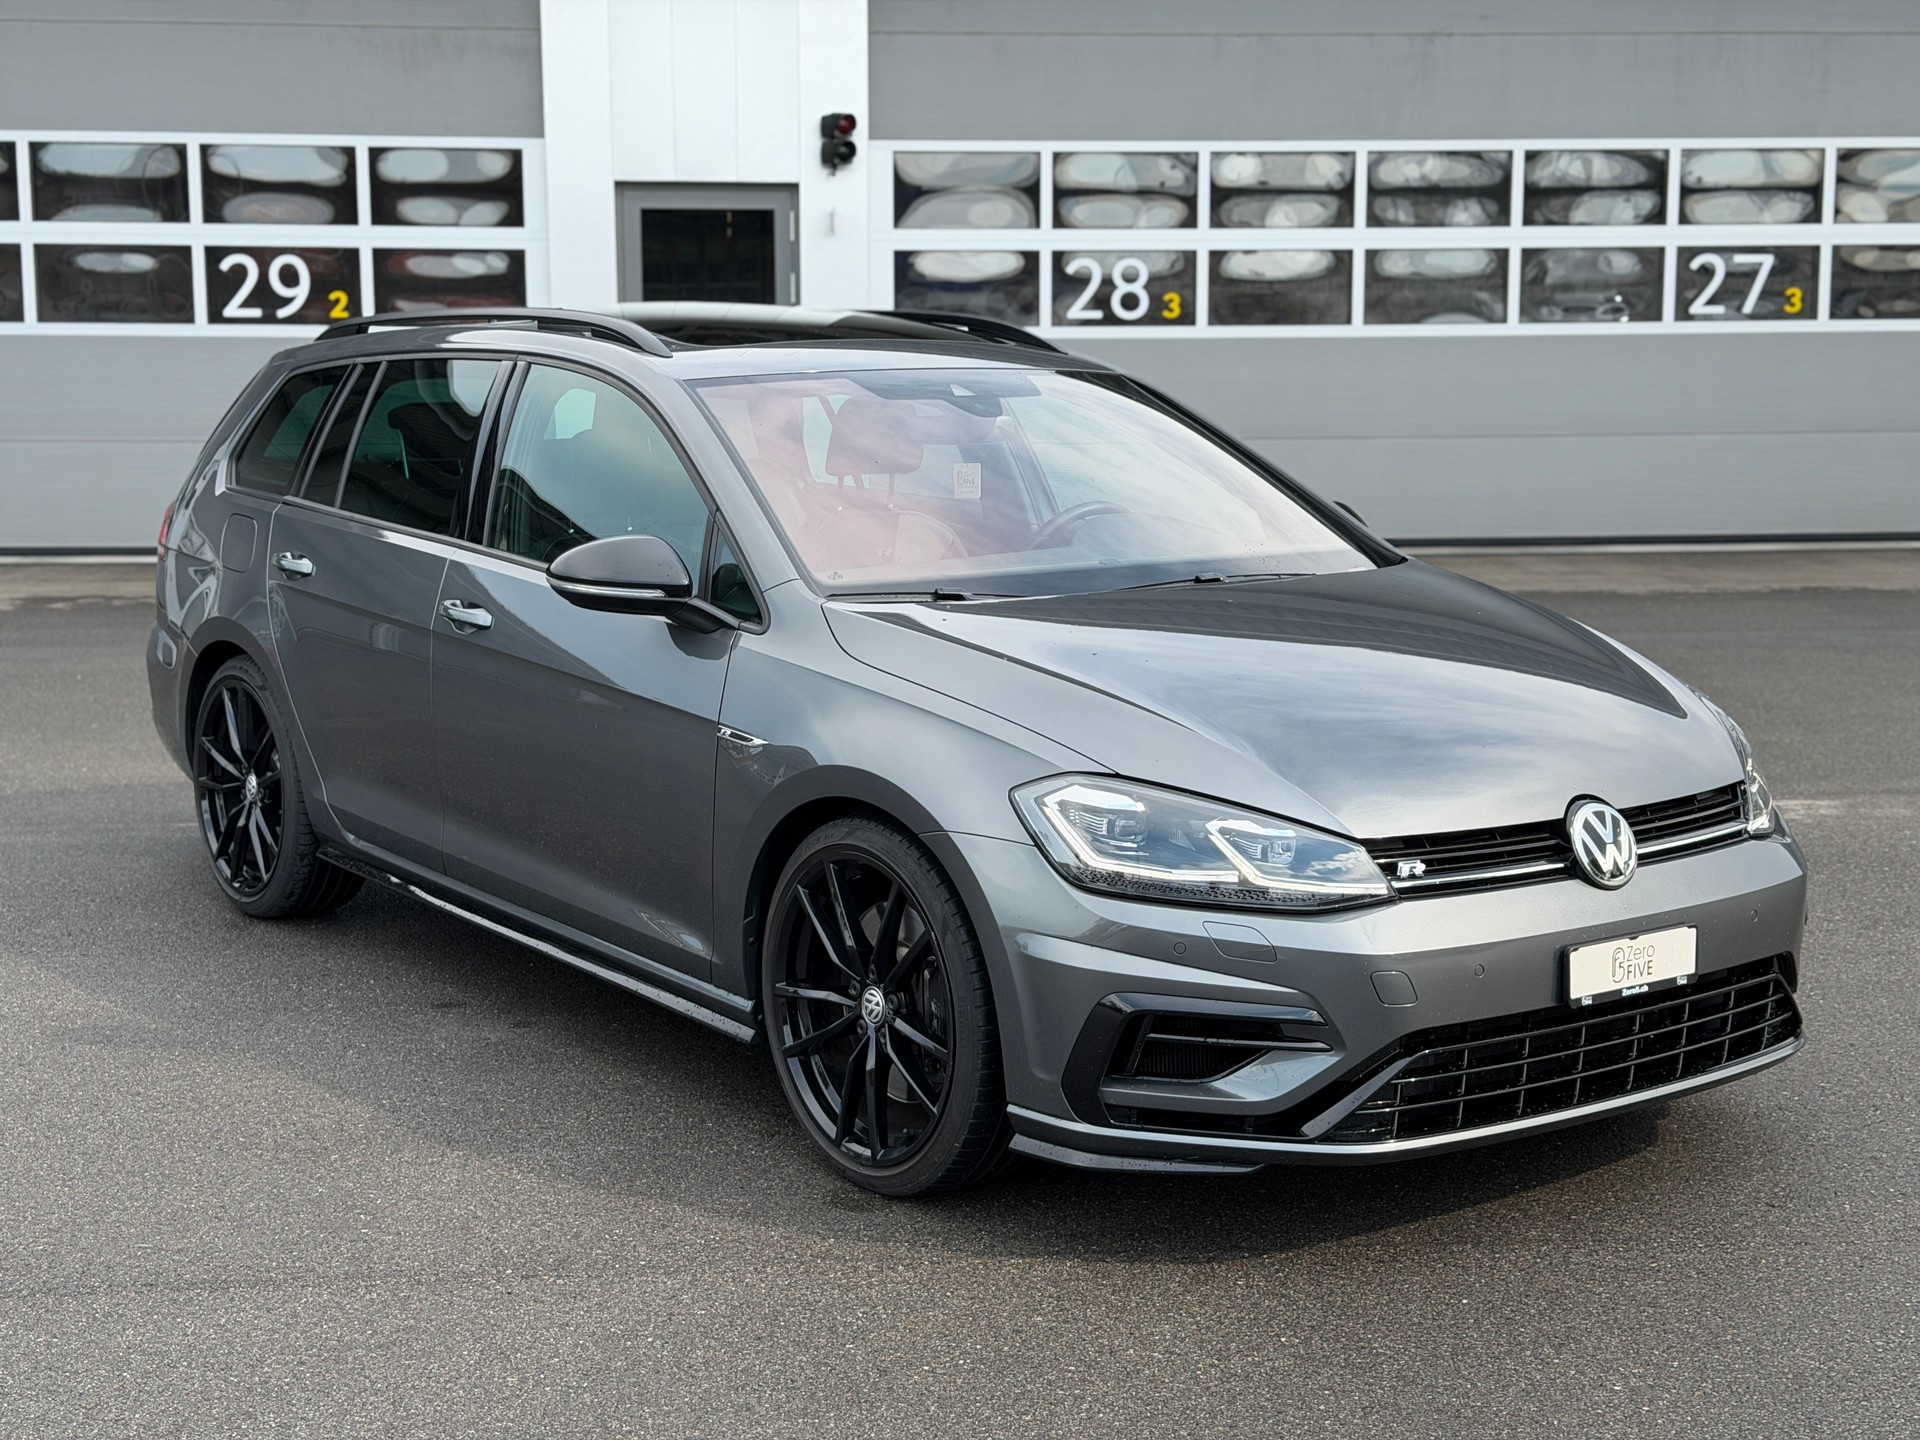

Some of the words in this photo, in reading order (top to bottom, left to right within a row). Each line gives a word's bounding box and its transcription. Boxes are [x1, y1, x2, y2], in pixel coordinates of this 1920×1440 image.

[218, 252, 312, 320] 29
[1064, 257, 1150, 321] 28
[1688, 252, 1775, 315] 27
[328, 290, 350, 319] 2
[1161, 292, 1182, 320] 3
[1783, 287, 1803, 314] 3
[1397, 860, 1426, 879] R
[1626, 944, 1656, 962] Zero
[1626, 959, 1654, 981] FIVE
